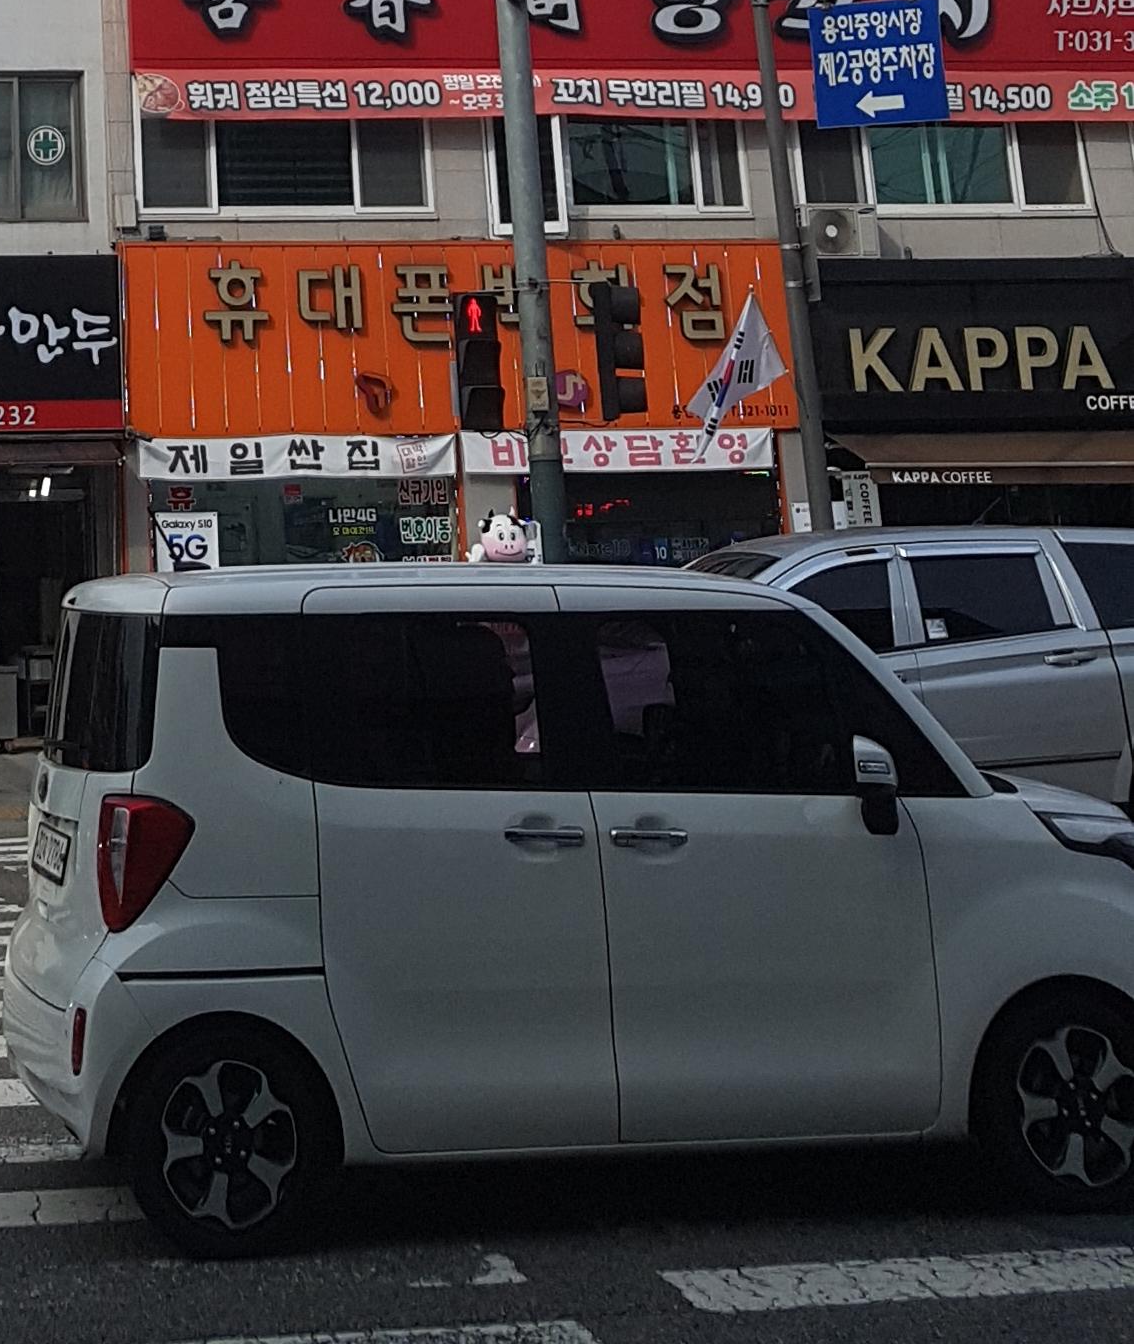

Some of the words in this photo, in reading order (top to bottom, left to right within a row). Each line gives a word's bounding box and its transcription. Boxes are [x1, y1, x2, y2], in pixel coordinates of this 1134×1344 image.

[821, 8, 923, 44] 용인중앙시장
[818, 43, 935, 86] 제2공영주차장
[187, 82, 240, 109] 훠궈
[245, 81, 348, 109] 점심특선
[353, 80, 441, 110] 12,000
[442, 74, 474, 90] 평일
[551, 78, 601, 105] 꼬치
[607, 79, 707, 108] 무한리필
[711, 82, 794, 111] 14,90
[1068, 80, 1119, 112] 소주
[970, 85, 1052, 113] 14,500
[848, 326, 1115, 393] KAPPA
[398, 478, 449, 505] 신규가입
[892, 472, 940, 484] KAPPA
[942, 471, 993, 484] COFFEE
[859, 482, 873, 524] COFFEE
[162, 519, 196, 531] Galaxy
[197, 519, 213, 529] S10
[399, 517, 452, 544] 번호이동
[168, 533, 208, 561] 5G
